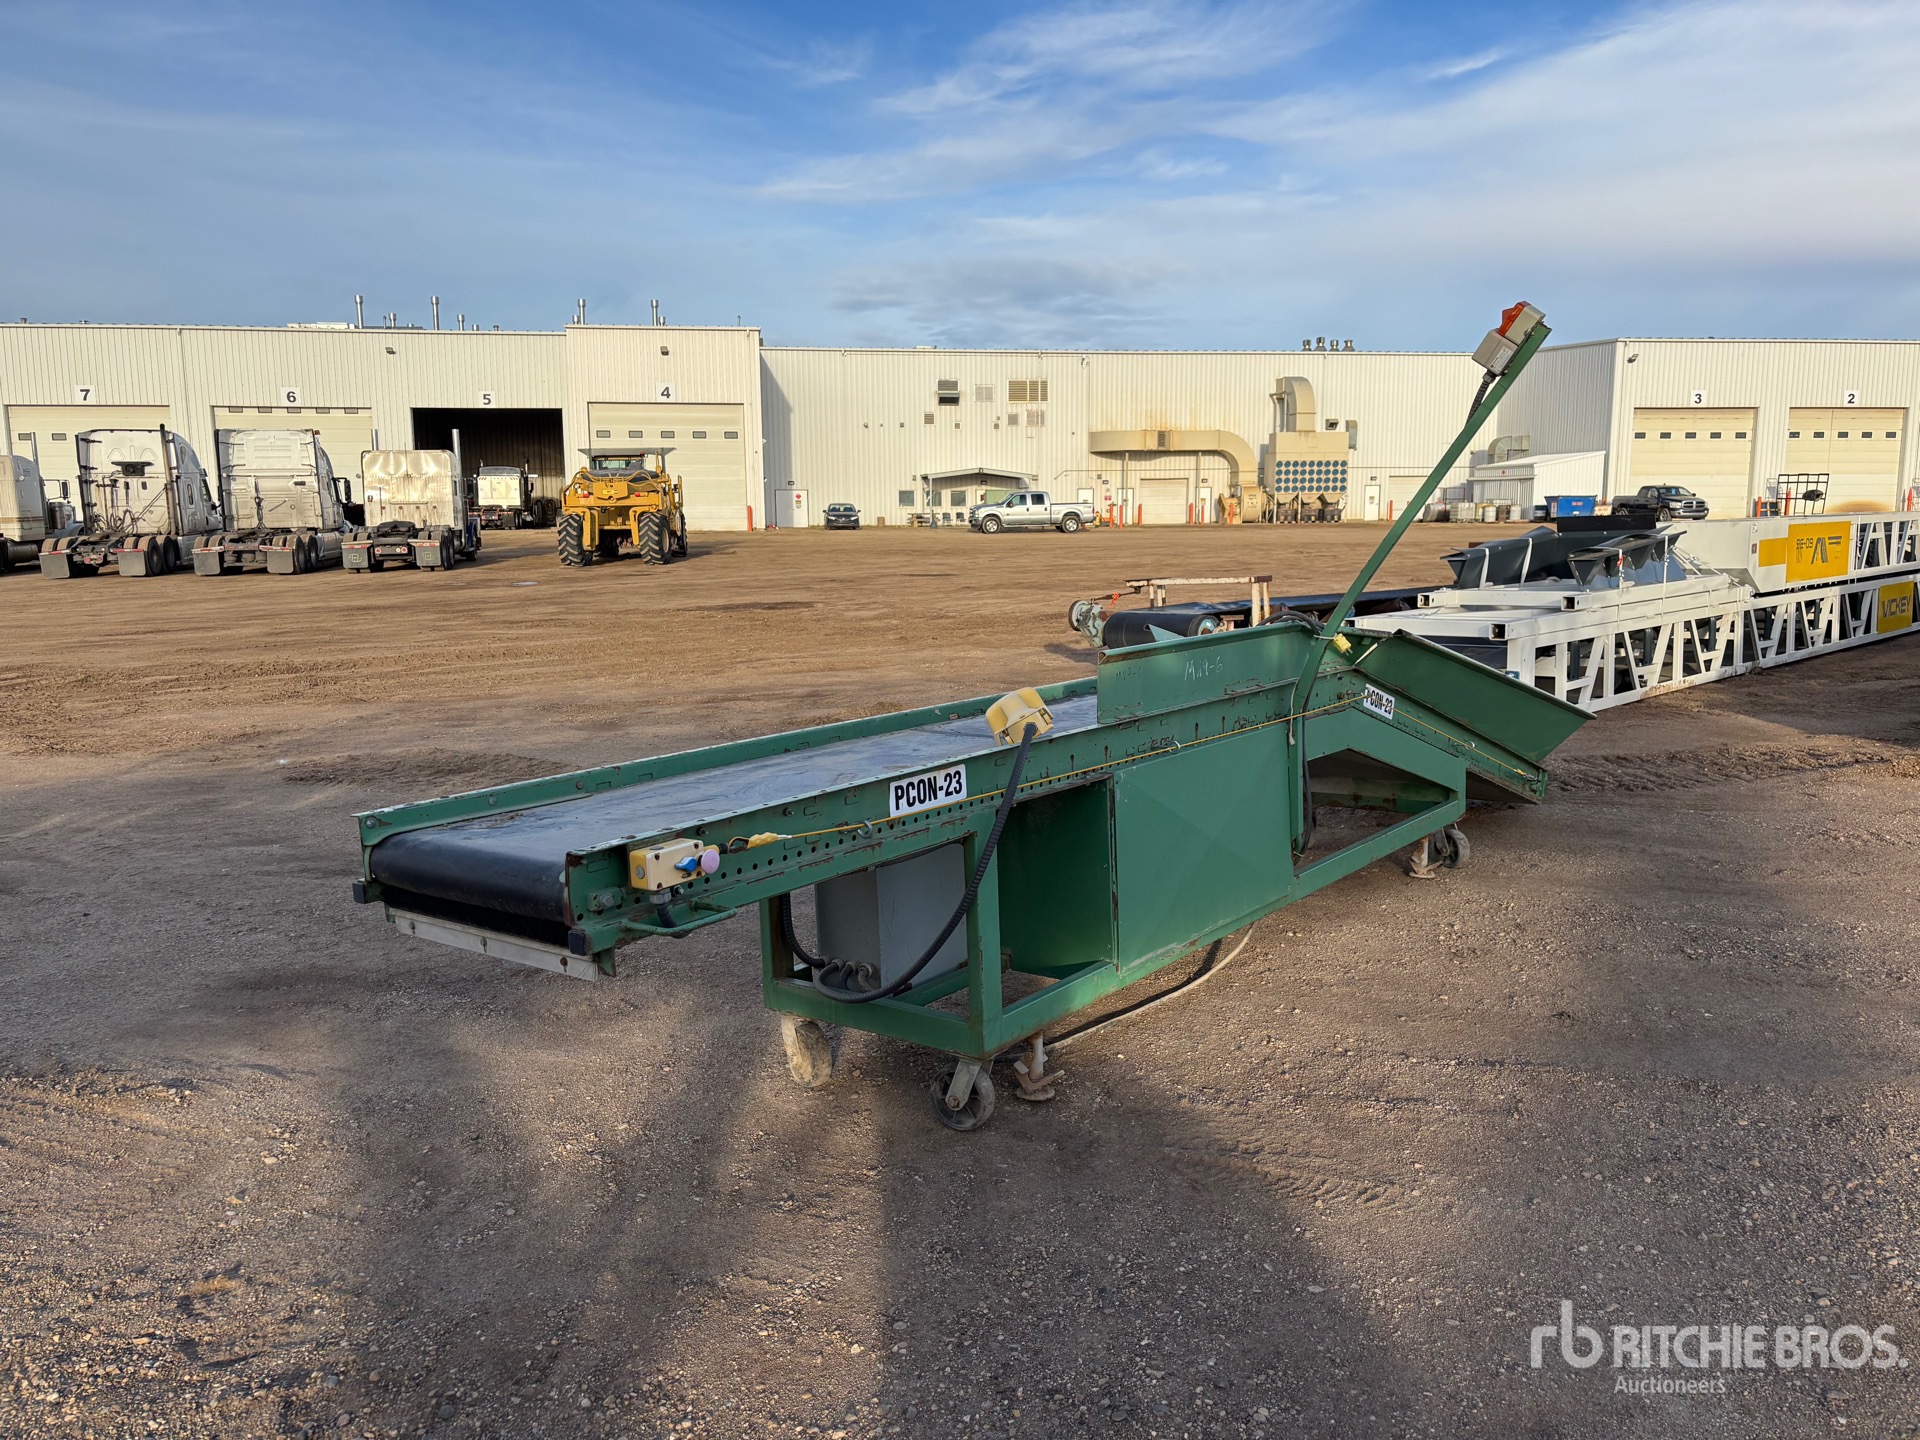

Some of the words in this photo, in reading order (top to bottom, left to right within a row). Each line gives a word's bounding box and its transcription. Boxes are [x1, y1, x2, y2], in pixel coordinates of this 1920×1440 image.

[79, 388, 91, 401] 7
[286, 391, 297, 403] 6
[660, 386, 671, 399] 4
[1694, 393, 1702, 404] 3
[1847, 393, 1855, 404] 2
[482, 393, 492, 405] 5
[894, 770, 963, 811] PCON-23
